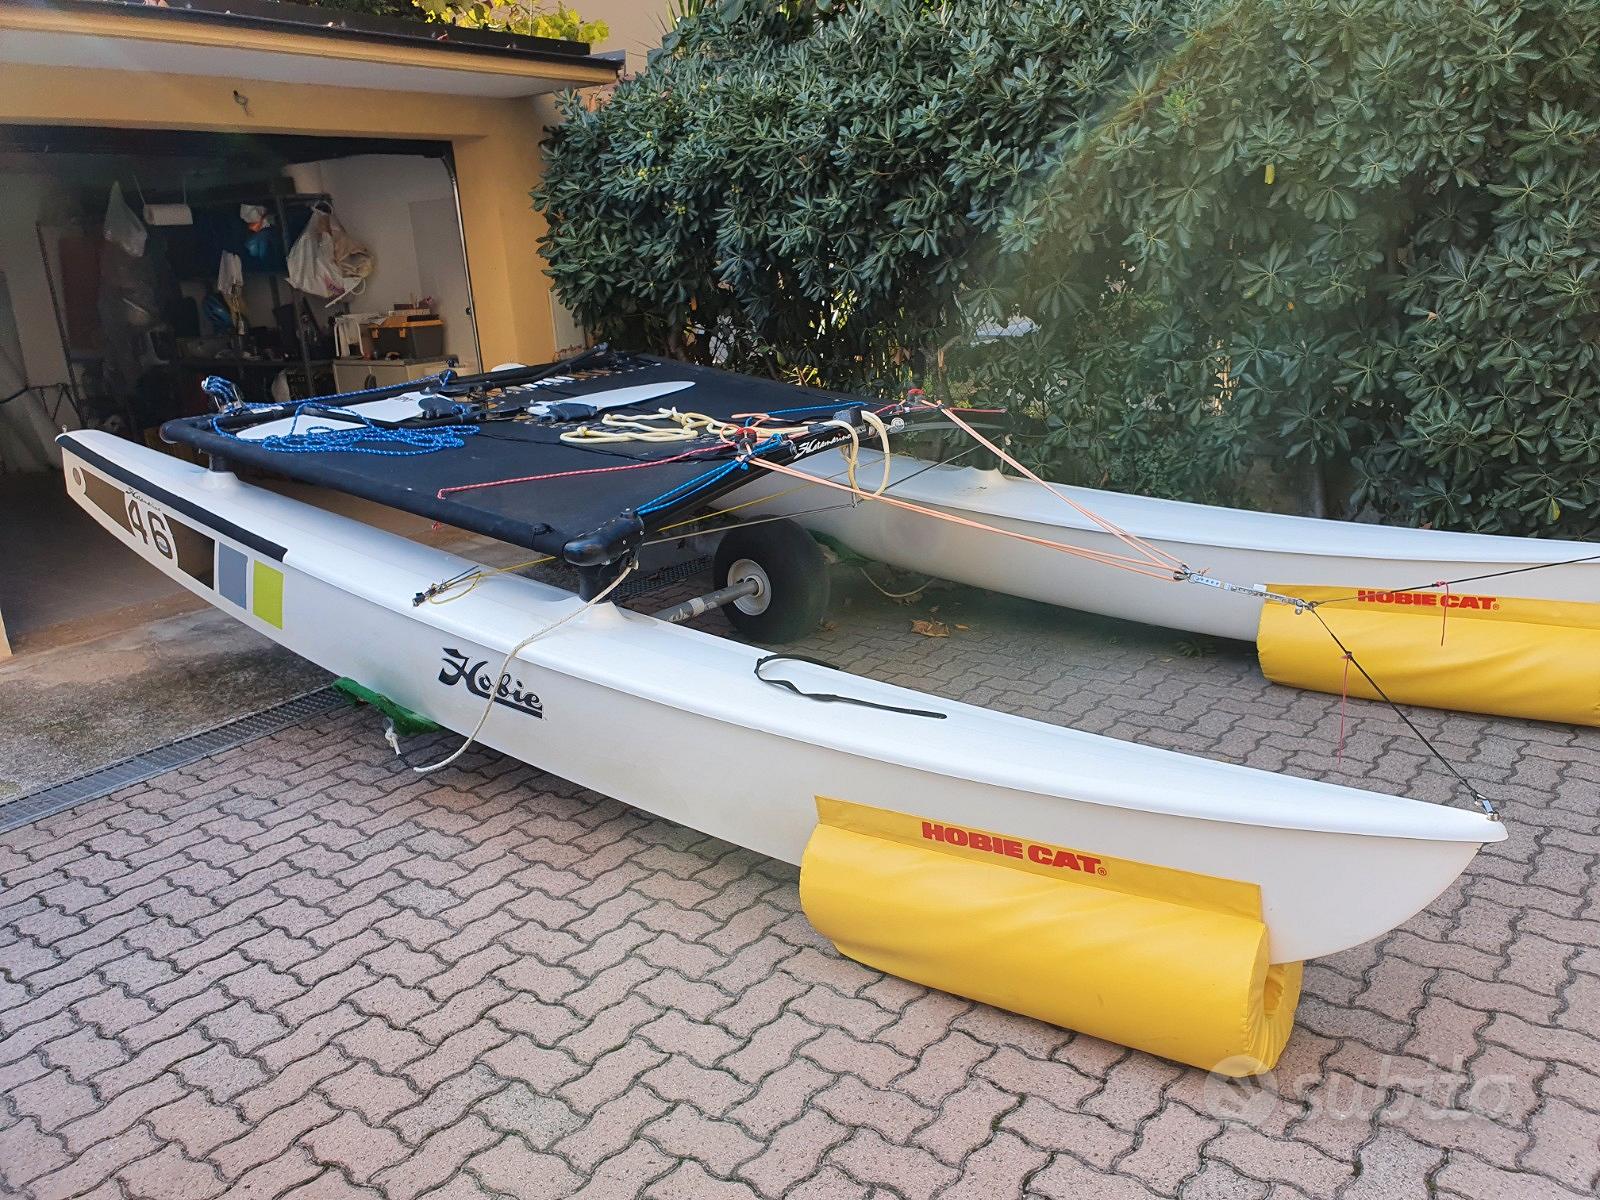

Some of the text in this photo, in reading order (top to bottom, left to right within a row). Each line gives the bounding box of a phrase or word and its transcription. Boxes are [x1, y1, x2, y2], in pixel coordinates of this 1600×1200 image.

[128, 499, 174, 560] 46
[1357, 589, 1497, 610] HOBIE CAT
[438, 647, 543, 719] Hobie
[921, 821, 1102, 874] HOBIE CAT
